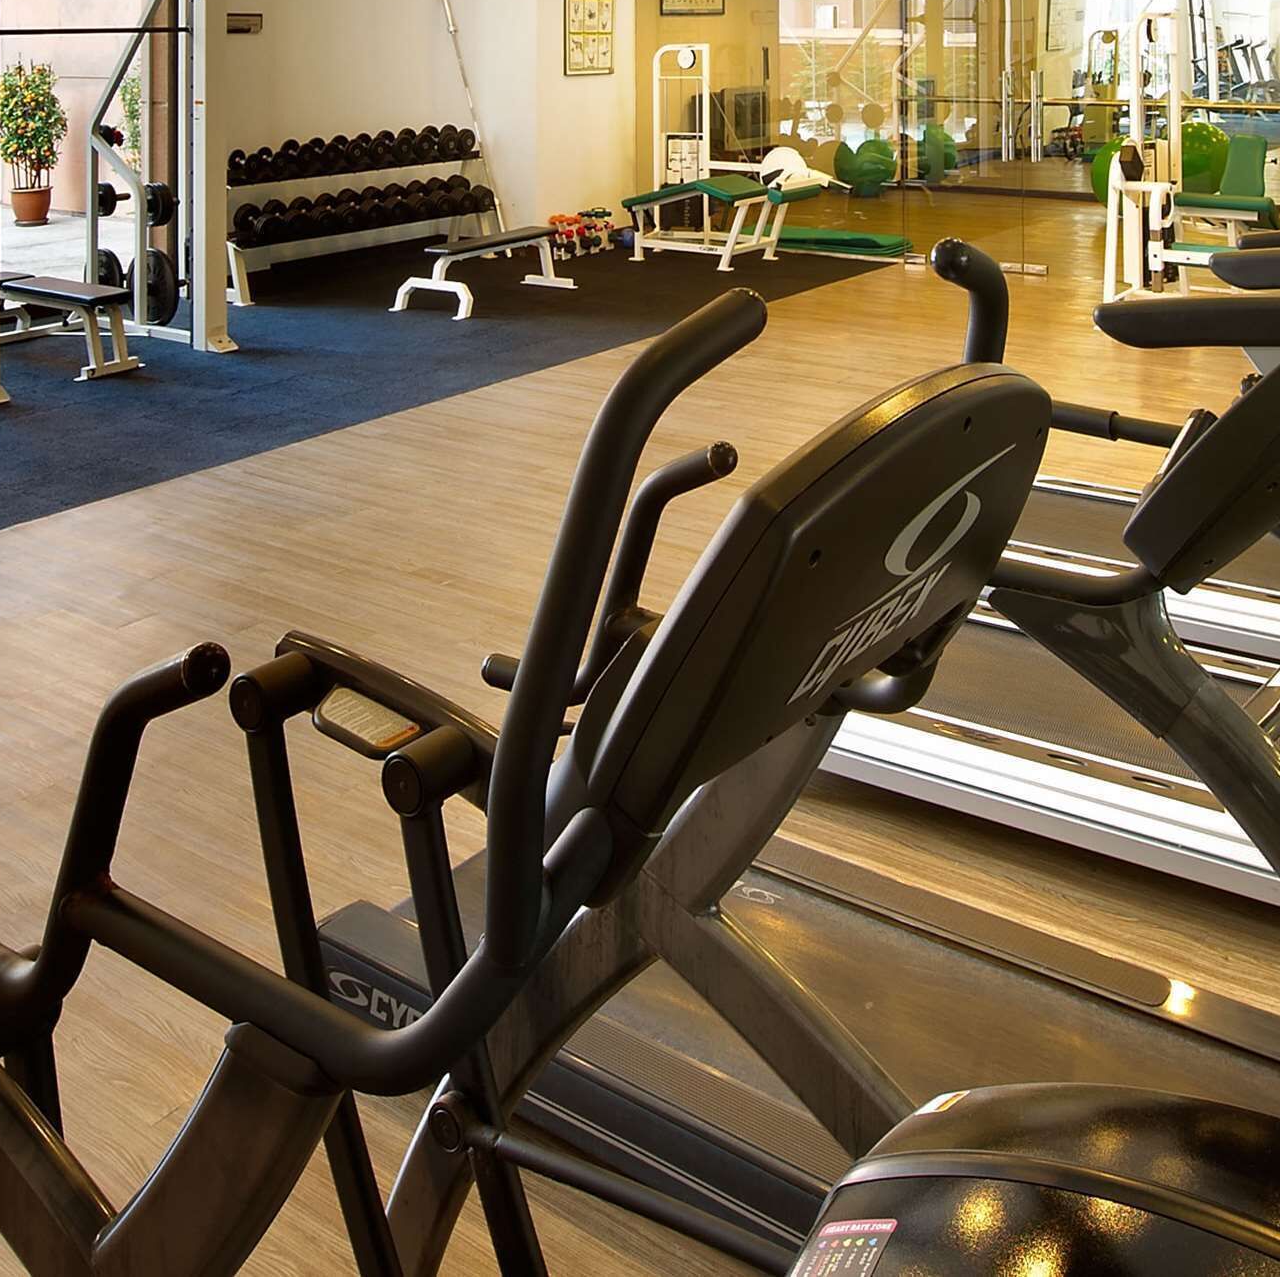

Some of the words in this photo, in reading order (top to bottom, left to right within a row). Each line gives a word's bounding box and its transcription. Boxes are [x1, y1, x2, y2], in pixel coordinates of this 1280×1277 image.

[786, 561, 952, 705] CYBEX
[825, 1225, 849, 1235] HEART
[851, 1224, 871, 1232] RATE
[871, 1223, 893, 1231] ZONE
